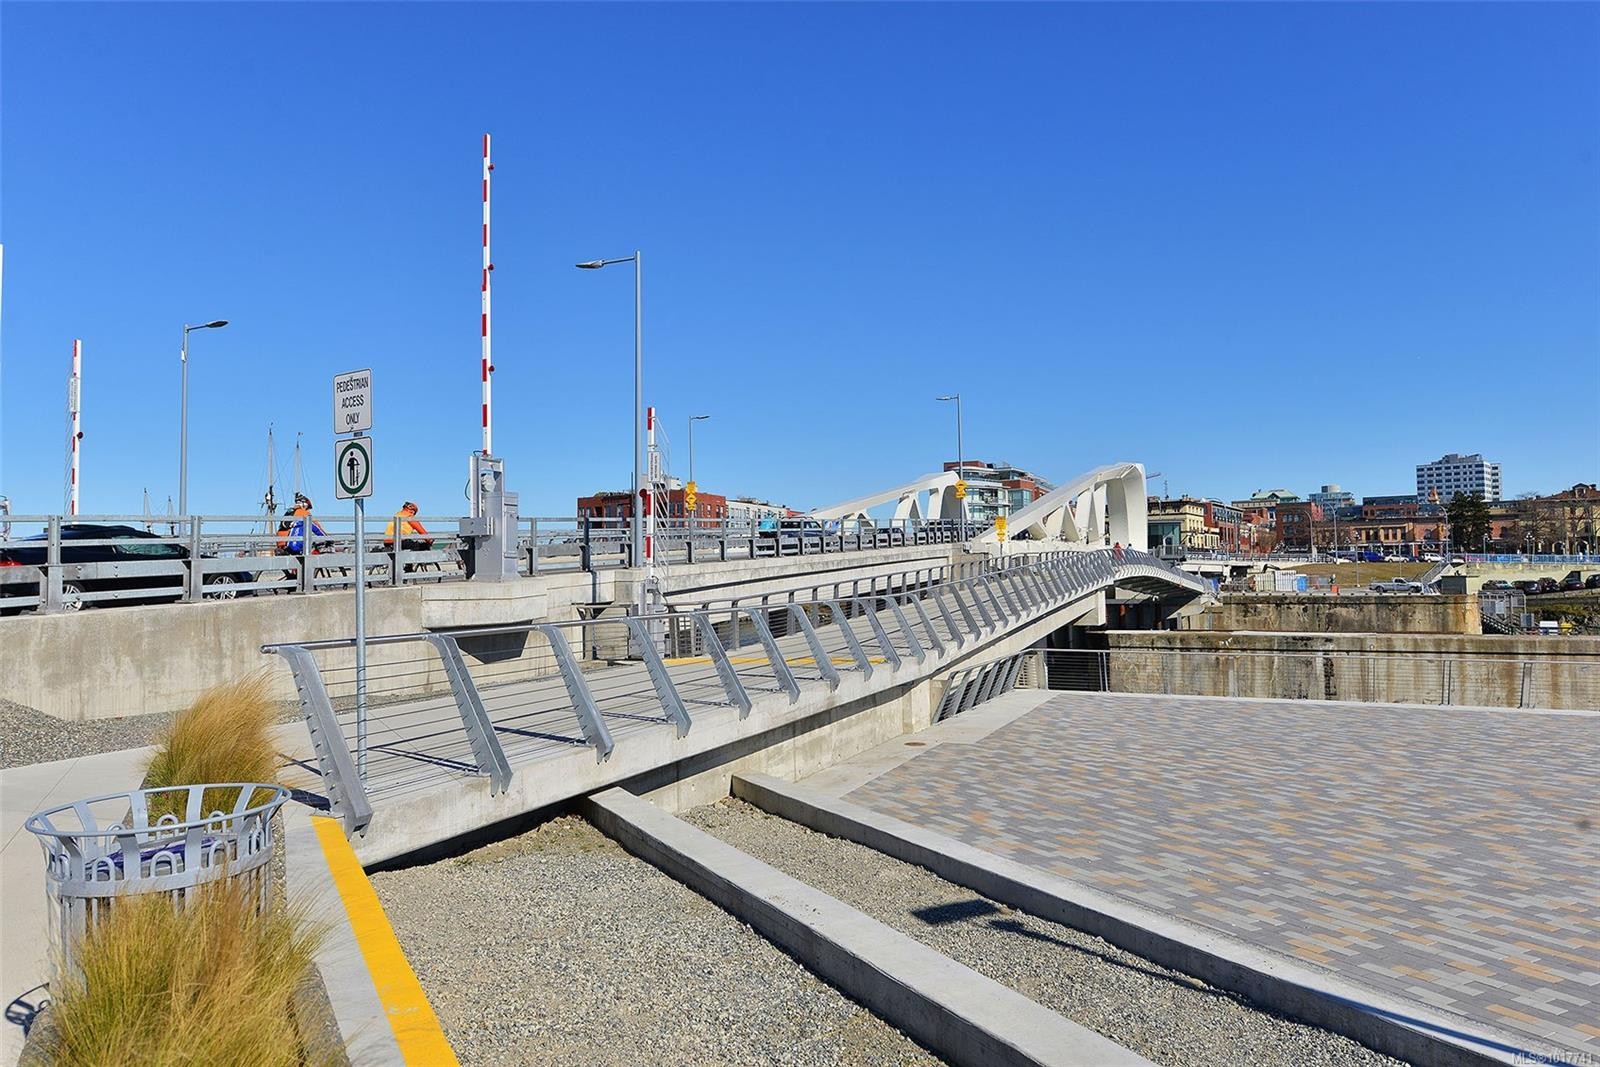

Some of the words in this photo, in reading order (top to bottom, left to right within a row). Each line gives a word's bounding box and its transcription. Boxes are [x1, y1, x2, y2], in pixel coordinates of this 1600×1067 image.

[336, 377, 369, 393] PEDESTRIAN
[341, 394, 365, 408] ACCESS
[345, 412, 360, 425] ONLY
